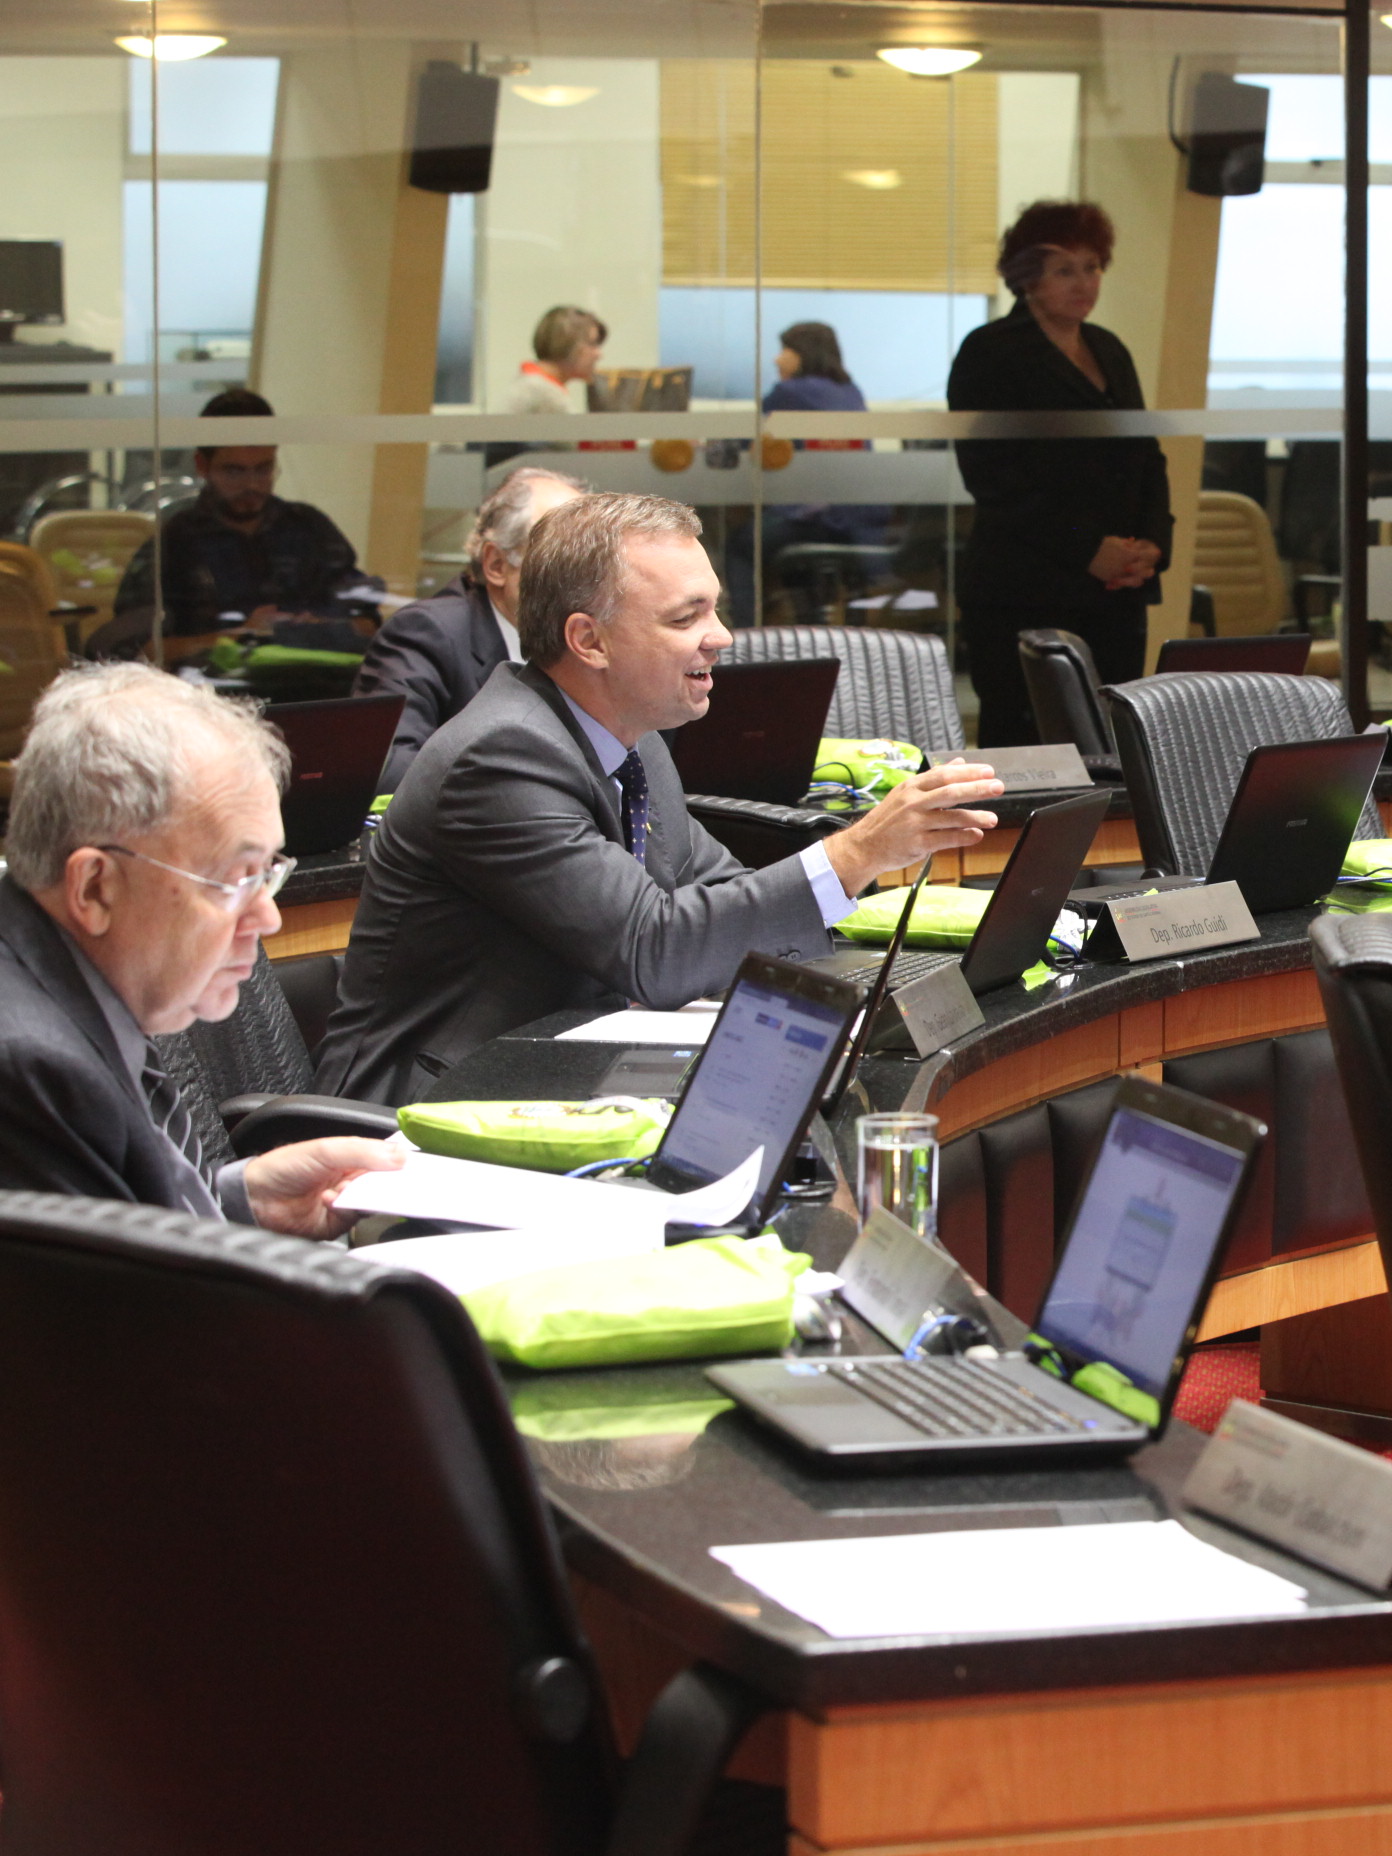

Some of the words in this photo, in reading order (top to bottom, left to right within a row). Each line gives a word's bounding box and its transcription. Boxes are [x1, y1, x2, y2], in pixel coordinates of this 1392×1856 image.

[1150, 927, 1173, 946] Dep.
[1171, 919, 1204, 939] Ricardo
[1203, 914, 1228, 933] Guidi
